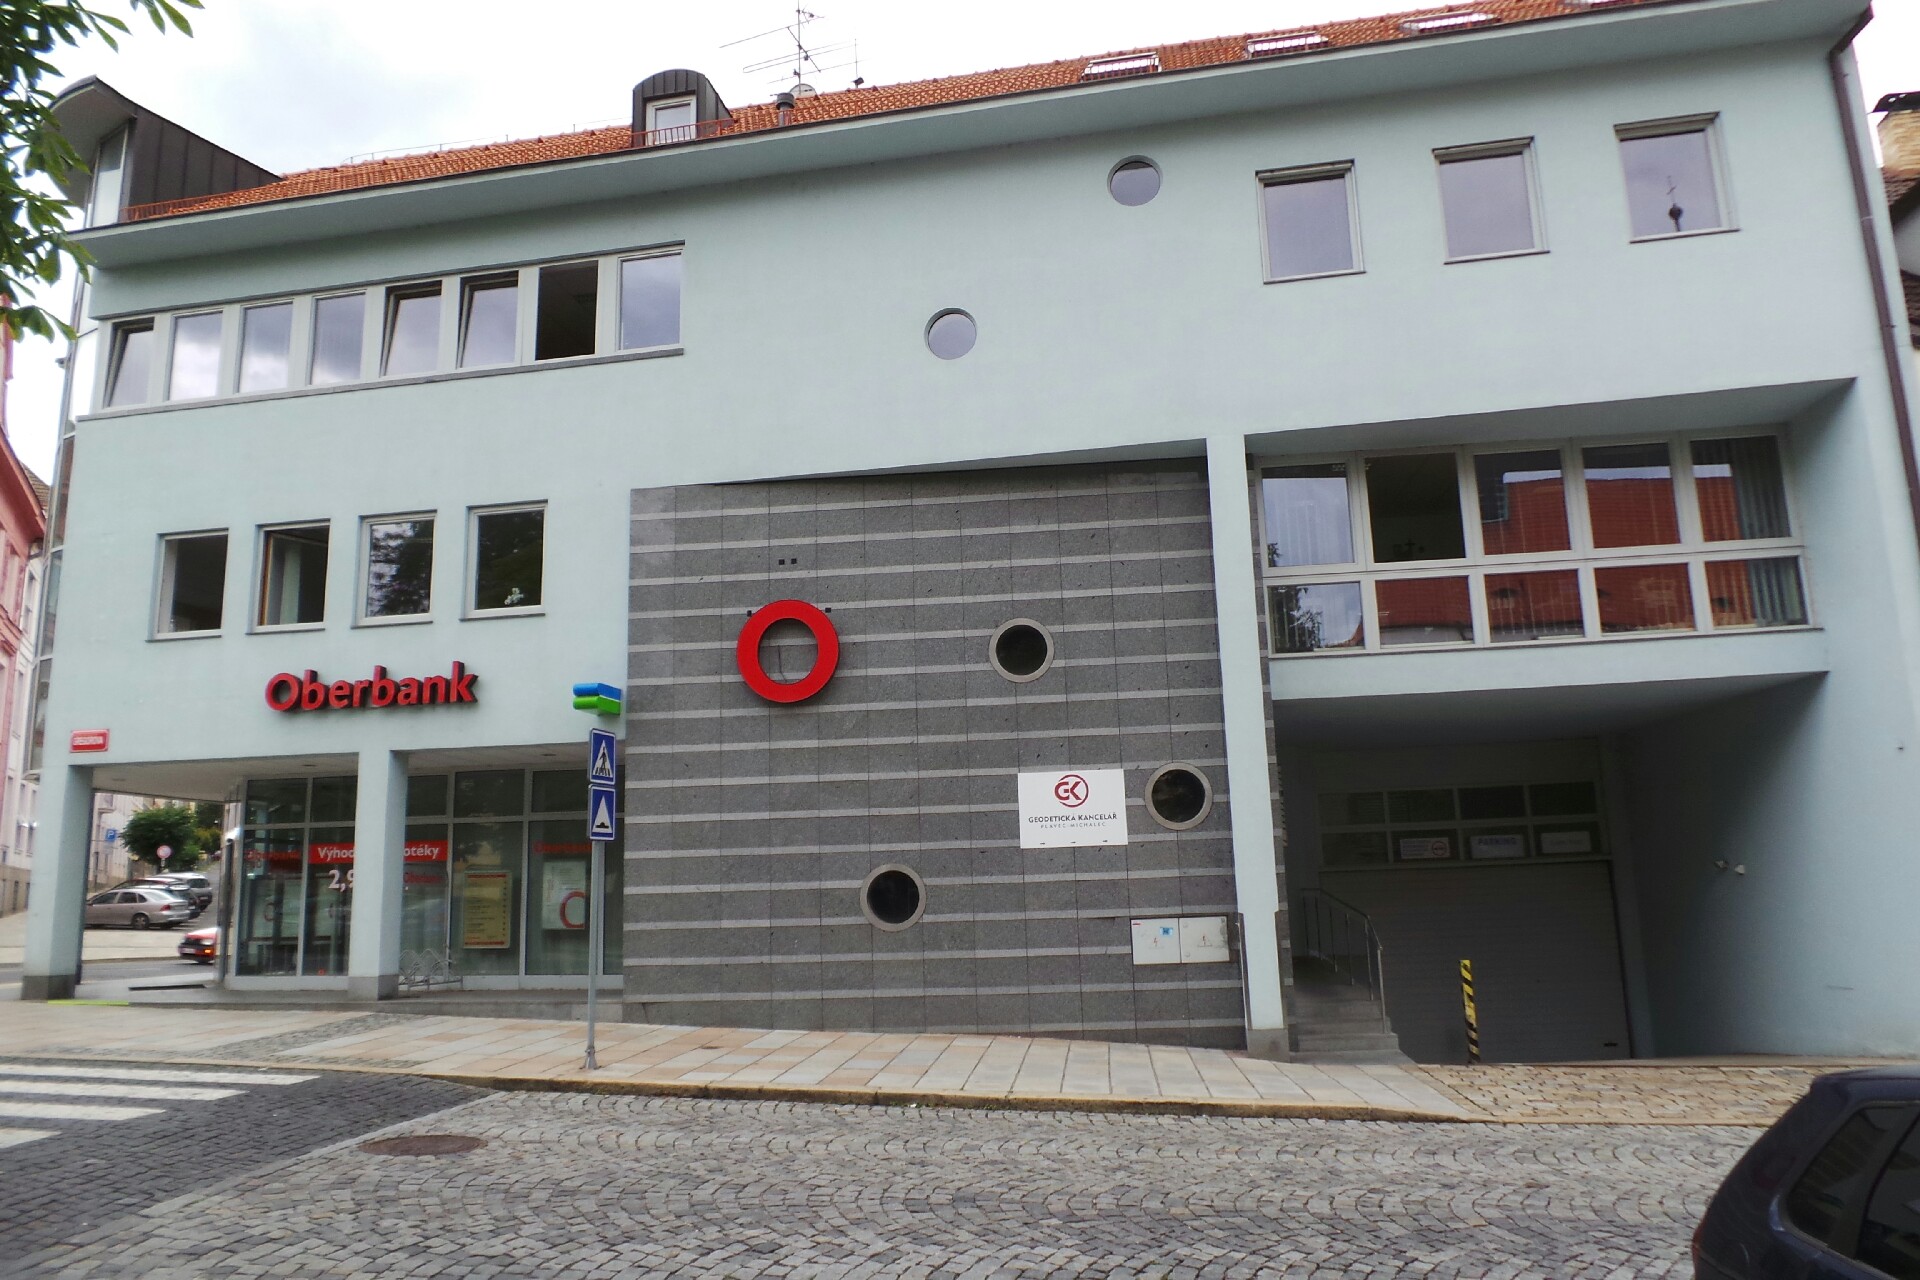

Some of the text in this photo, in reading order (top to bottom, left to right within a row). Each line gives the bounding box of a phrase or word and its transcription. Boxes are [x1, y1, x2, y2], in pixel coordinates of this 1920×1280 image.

[265, 660, 479, 712] Oberbank
[1028, 812, 1117, 823] GEODETICKÁ KANCELÁŘ
